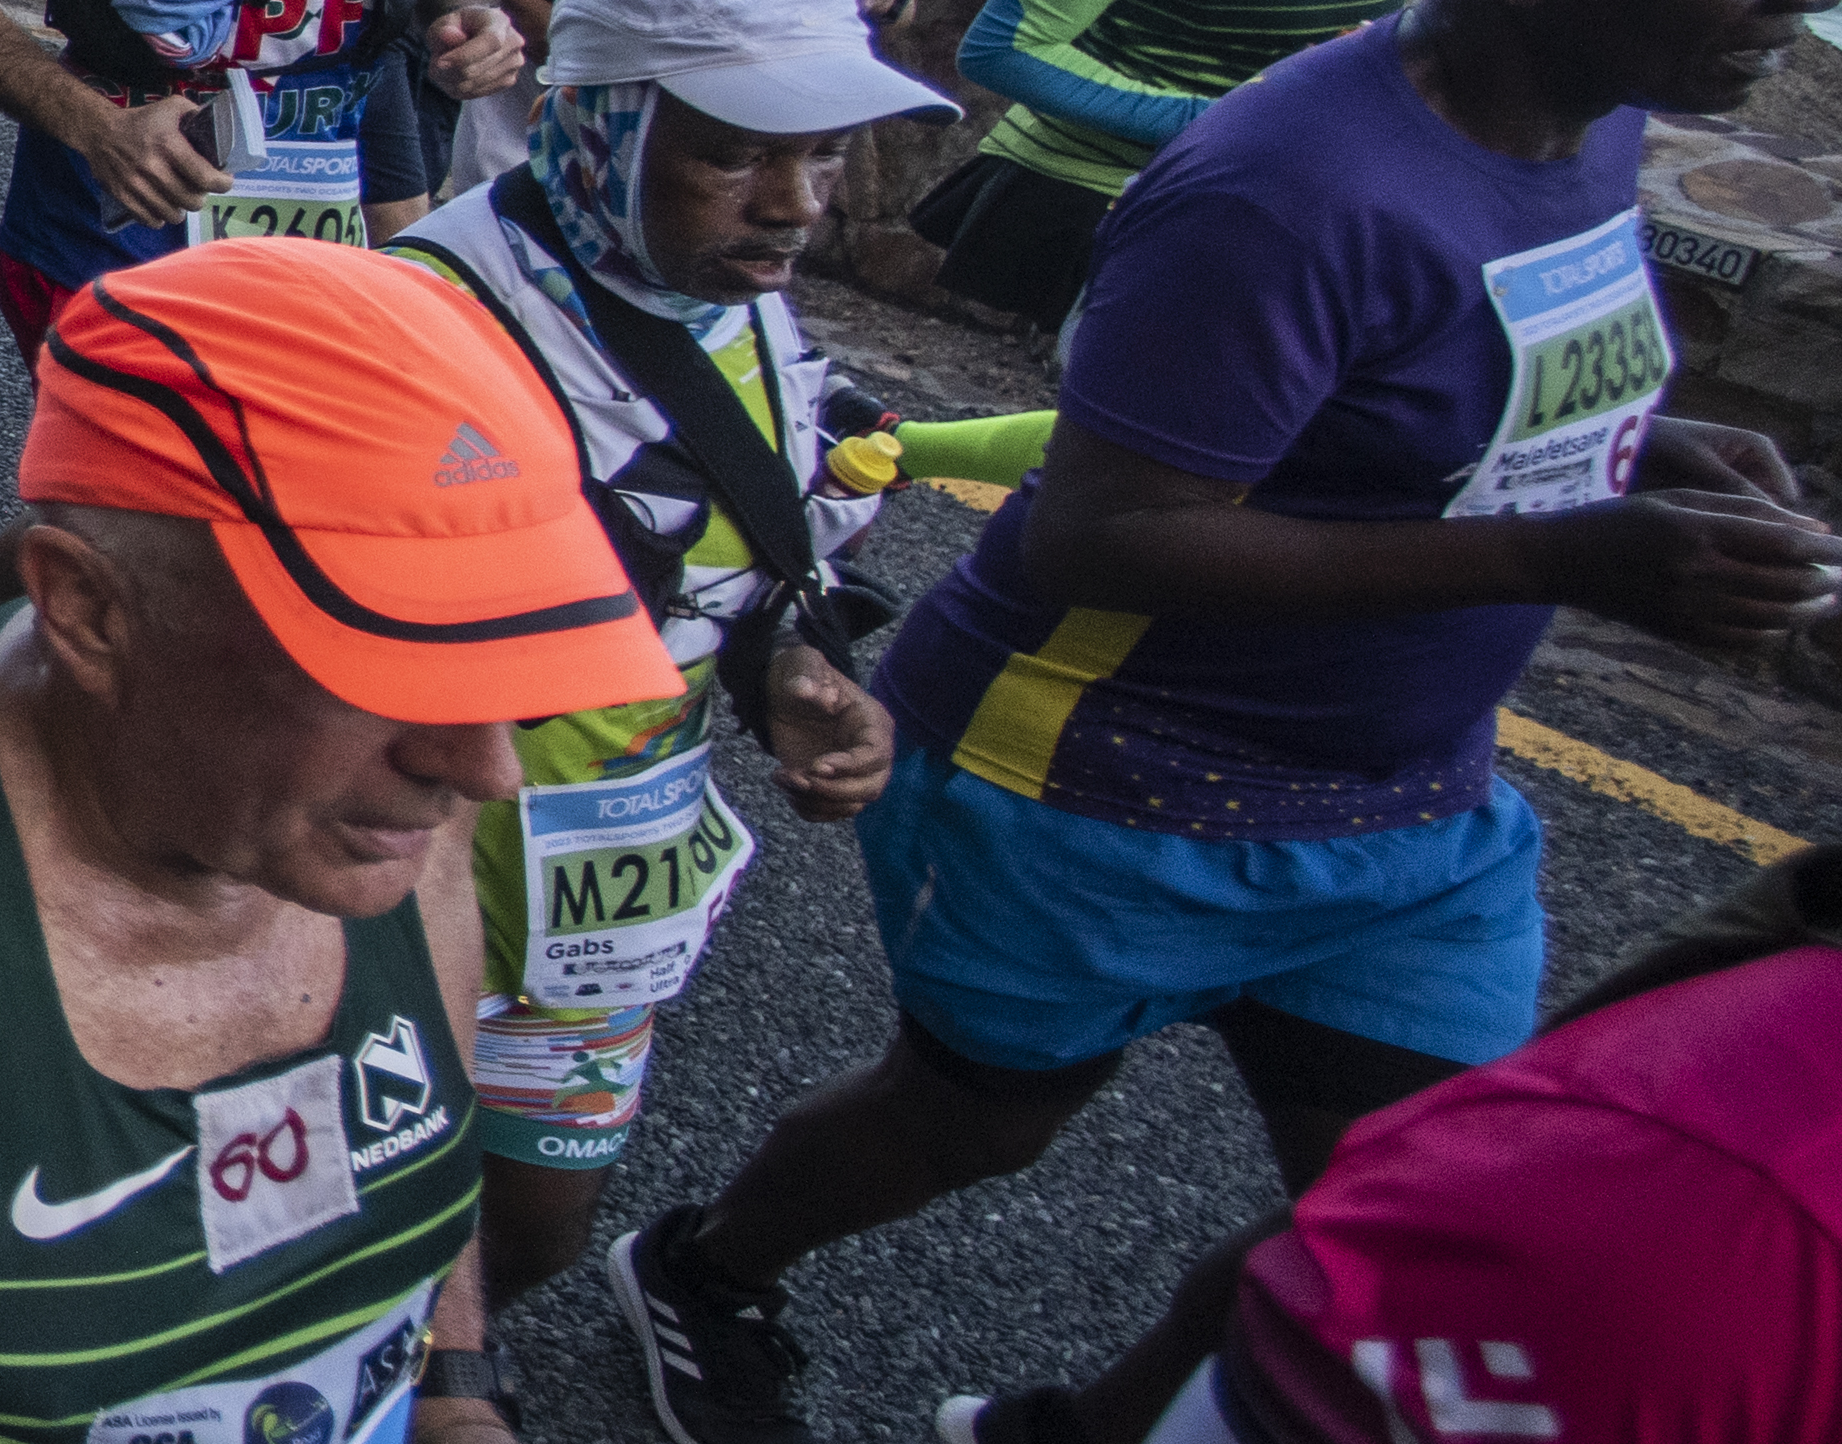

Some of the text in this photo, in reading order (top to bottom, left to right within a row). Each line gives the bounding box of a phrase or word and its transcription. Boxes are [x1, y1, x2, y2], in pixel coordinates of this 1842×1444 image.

[261, 155, 357, 175] OTALSPORT
[1606, 414, 1639, 495] 6
[434, 458, 520, 487] adidas
[596, 769, 707, 820] TOTALSPO
[545, 938, 615, 960] Gabs
[649, 963, 676, 980] Half
[649, 976, 680, 993] Ultra
[351, 1105, 451, 1174] NEDBANK
[208, 1106, 310, 1203] 60
